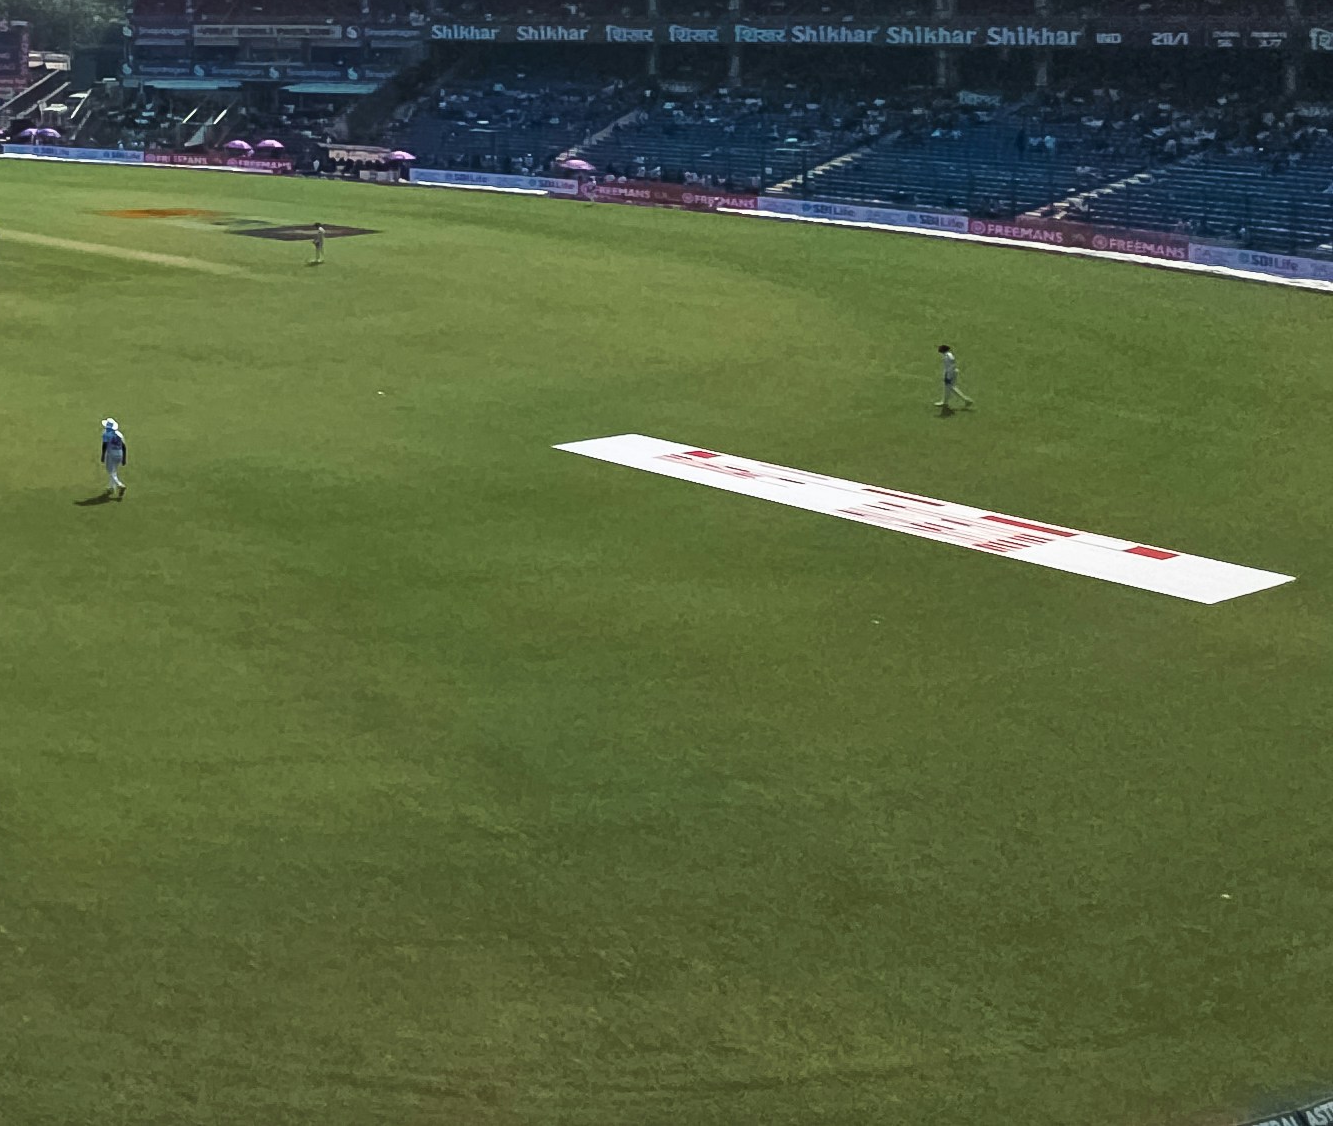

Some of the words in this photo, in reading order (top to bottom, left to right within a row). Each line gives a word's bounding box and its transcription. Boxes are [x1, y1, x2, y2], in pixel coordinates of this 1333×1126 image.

[431, 25, 500, 40] Shikhar
[517, 25, 589, 41] Shikhar
[791, 25, 878, 43] Shikhar
[886, 26, 978, 44] Shikhar
[987, 26, 1082, 46] Shikhar
[986, 224, 1064, 244] FREEMANS
[1109, 238, 1185, 259] FREEMANS
